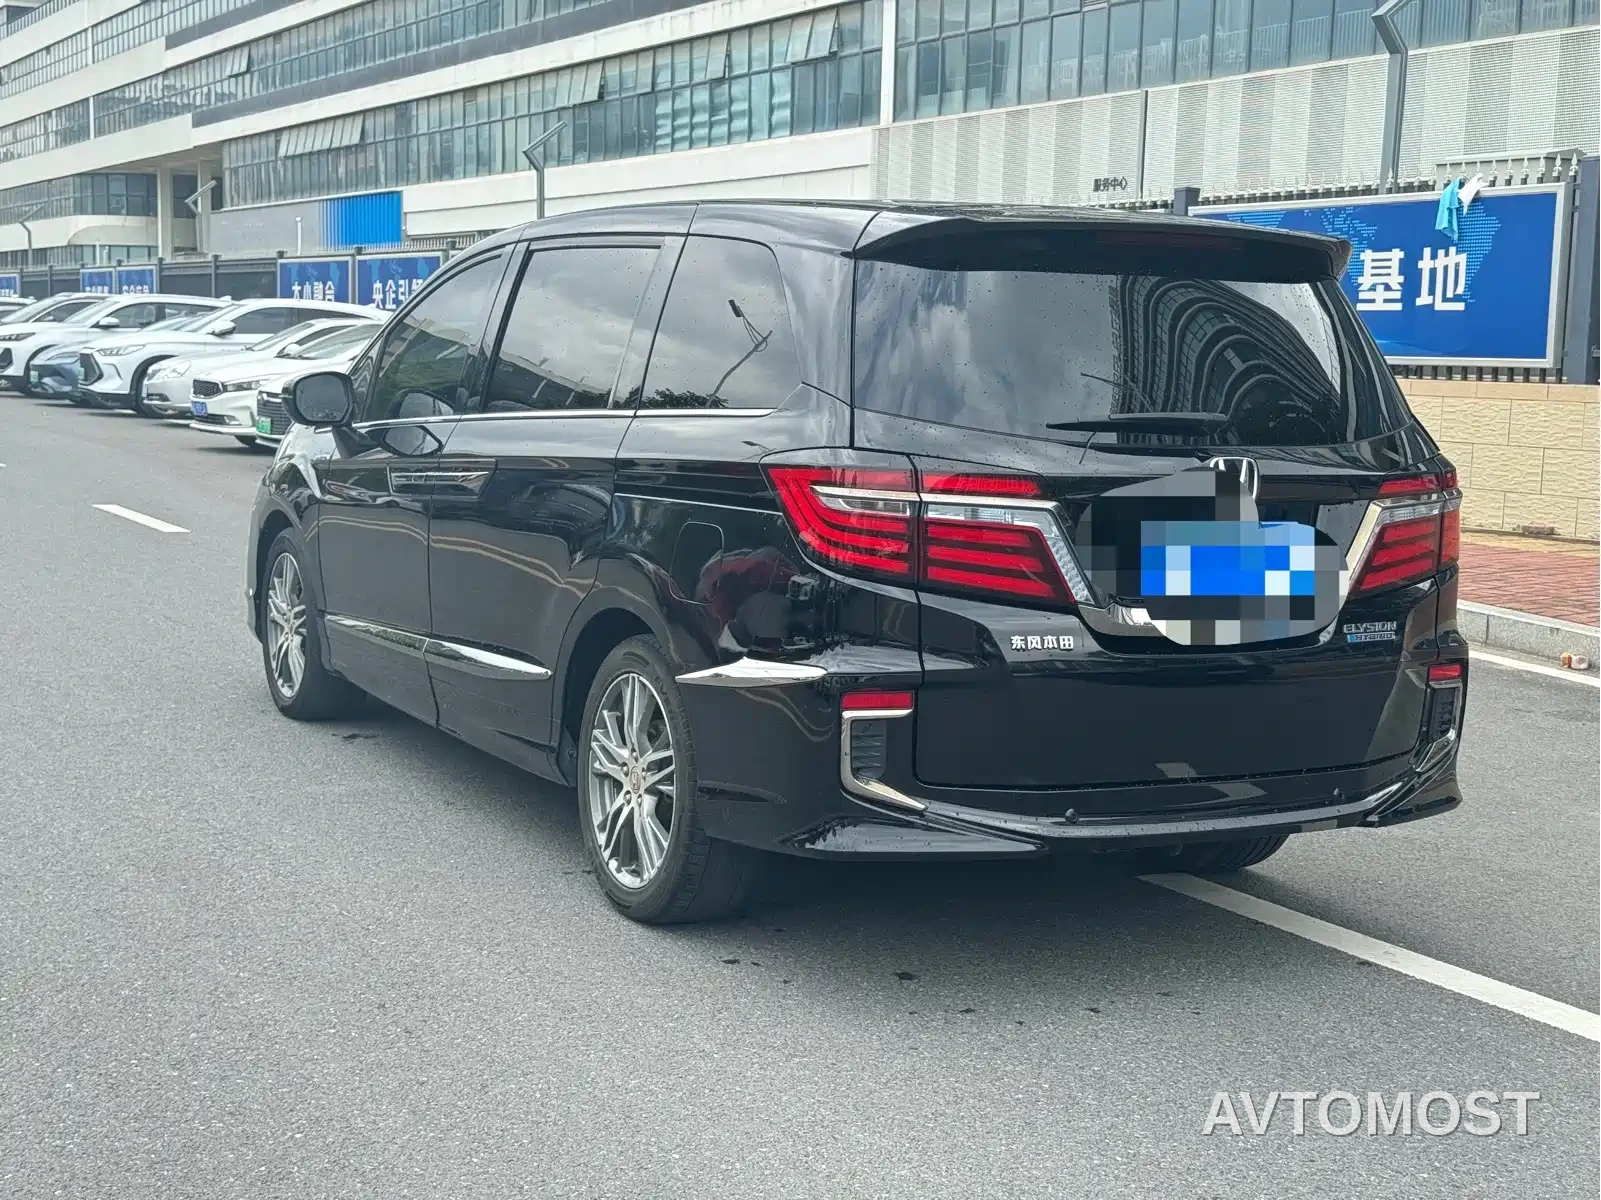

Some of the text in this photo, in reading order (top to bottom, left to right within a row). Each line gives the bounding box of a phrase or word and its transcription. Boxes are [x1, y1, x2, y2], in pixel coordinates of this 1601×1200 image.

[1093, 176, 1128, 192] 服务中心
[1356, 246, 1467, 311] 基地
[1343, 621, 1397, 633] ELYSION
[1010, 635, 1074, 650] 东风本田
